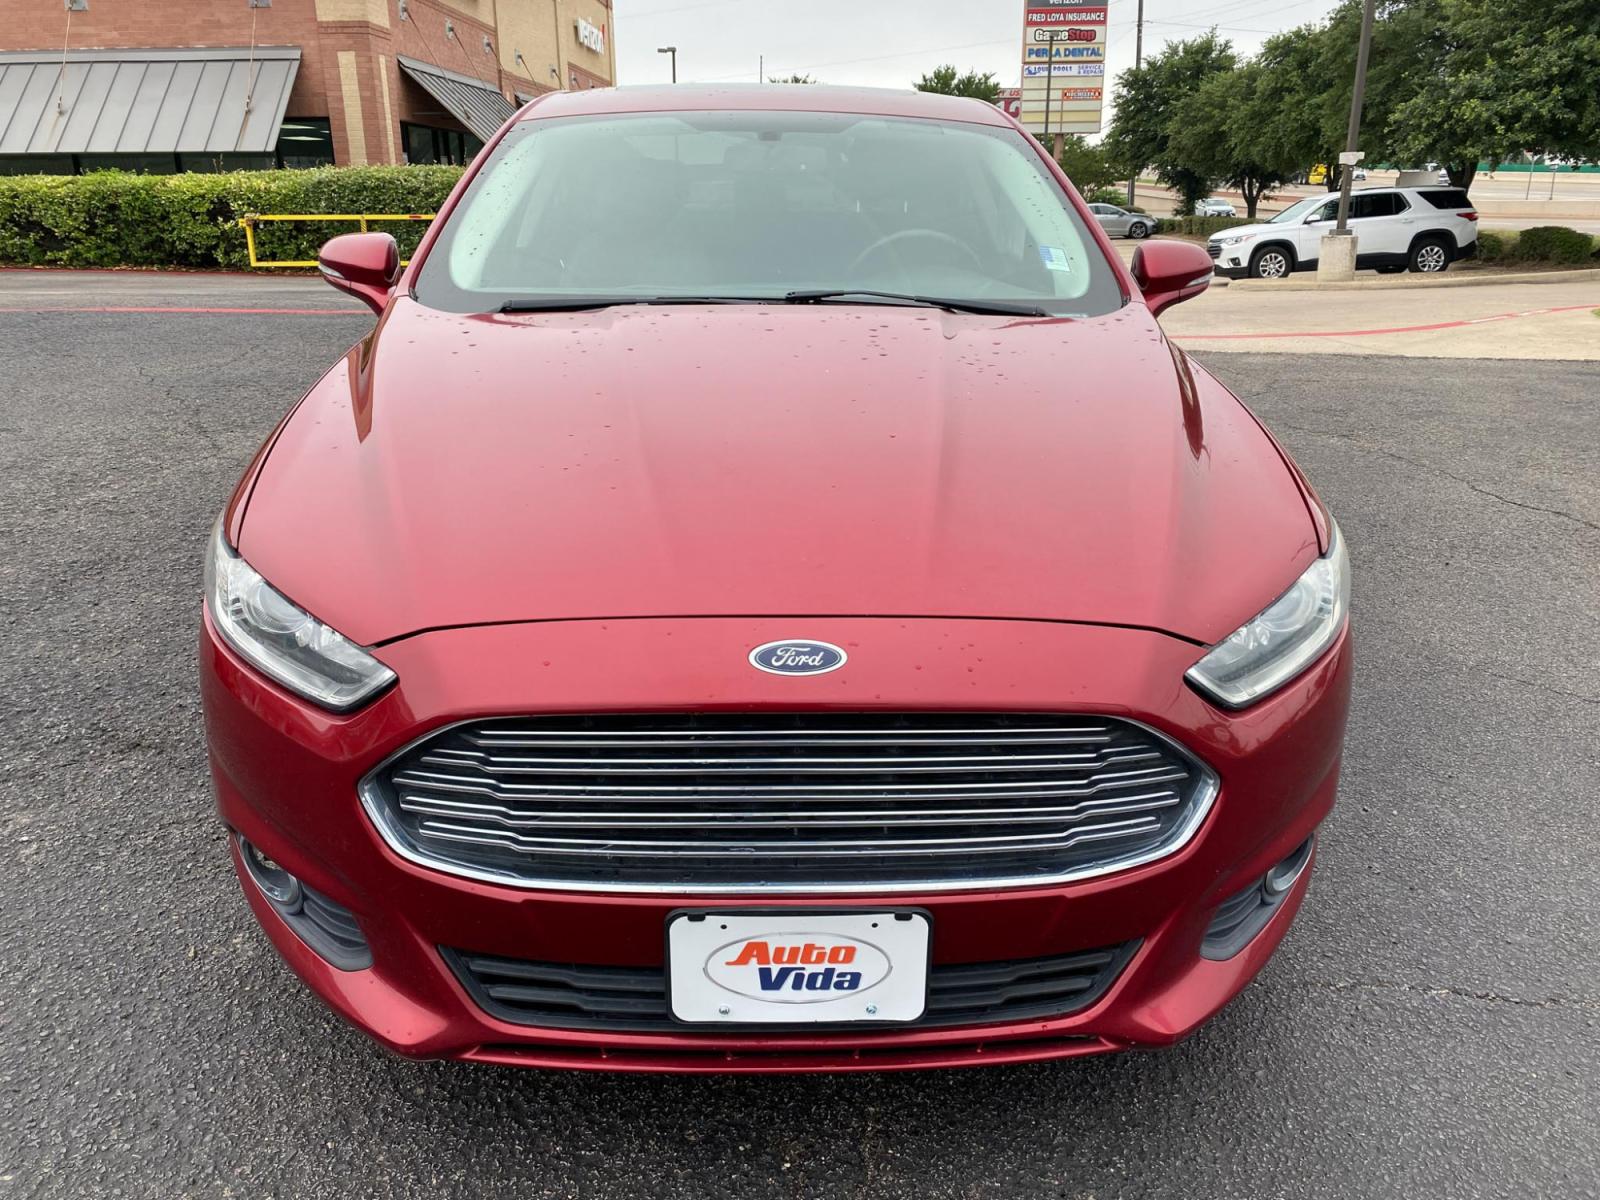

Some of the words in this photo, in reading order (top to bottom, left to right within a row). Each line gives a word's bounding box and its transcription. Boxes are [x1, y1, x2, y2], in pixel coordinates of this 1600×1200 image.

[1028, 13, 1046, 22] FRED
[1047, 13, 1064, 22] LOYA
[1065, 12, 1105, 21] INSURANCE
[1028, 48, 1061, 58] PERA
[1064, 47, 1102, 57] DENTAL
[771, 647, 824, 666] Ford
[725, 941, 857, 966] Auto
[758, 967, 862, 991] Vida
